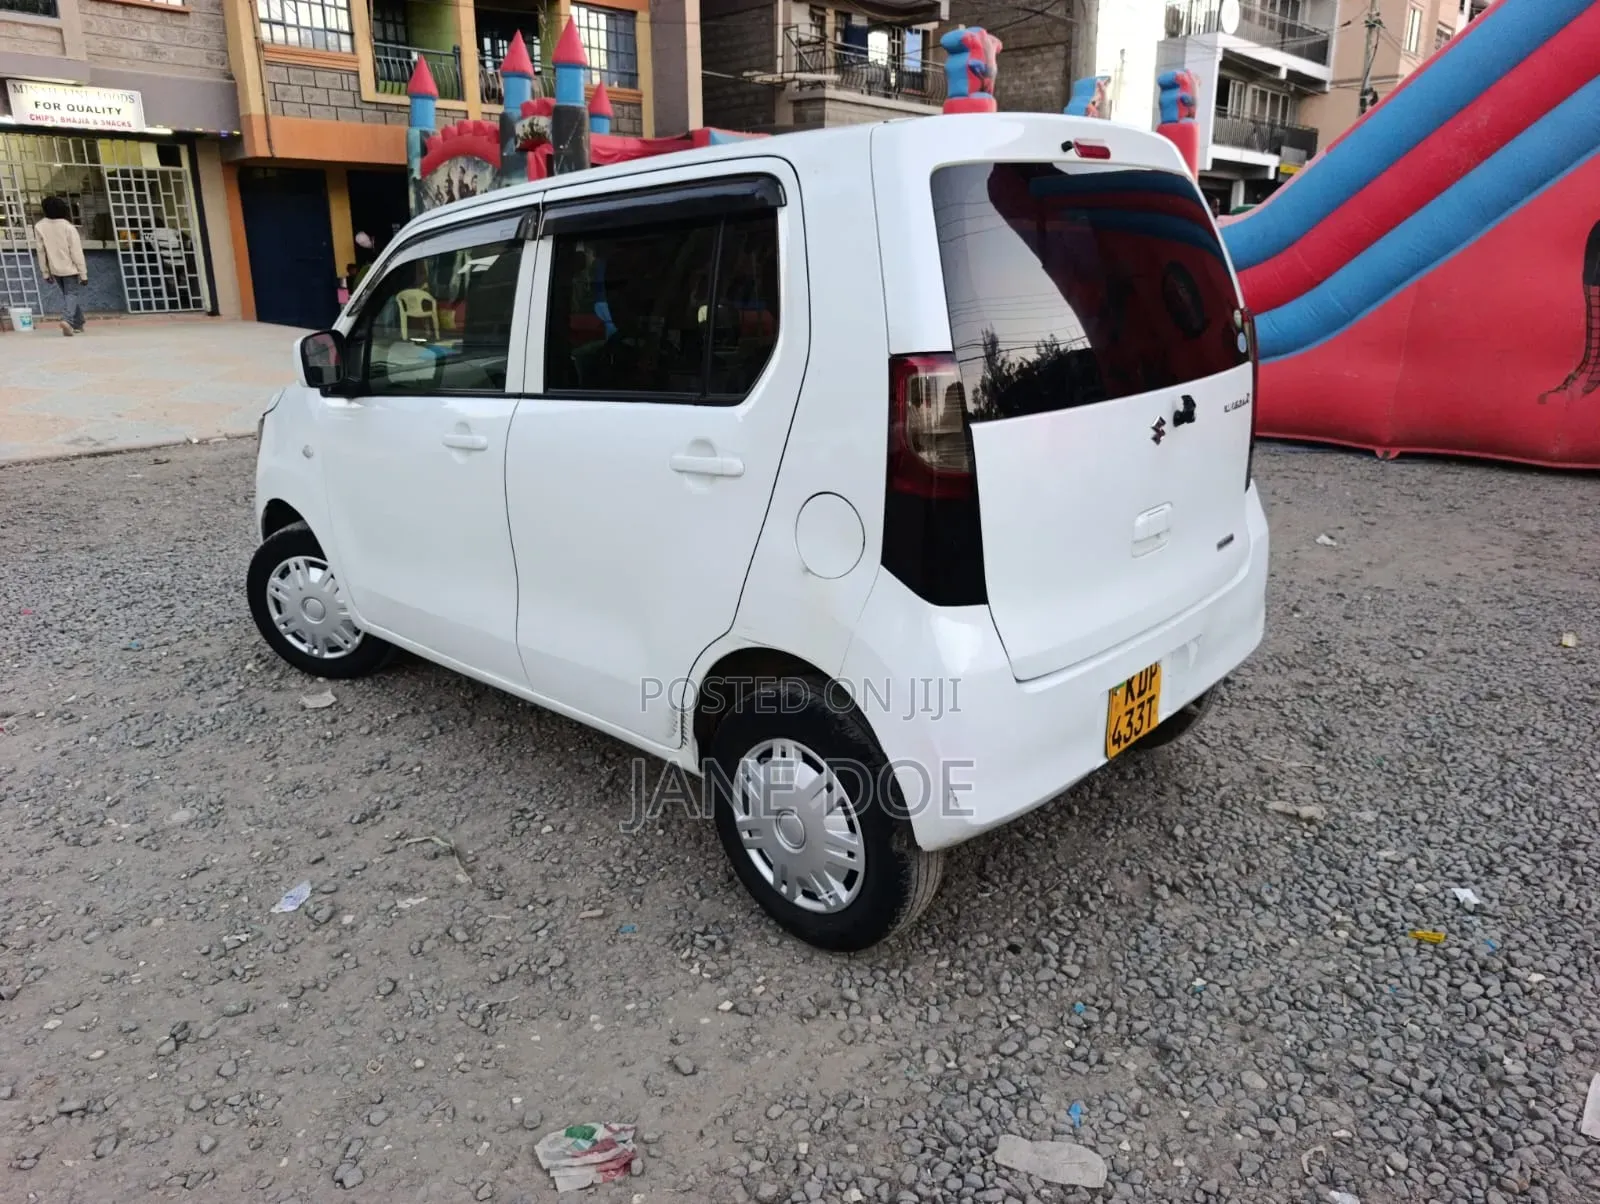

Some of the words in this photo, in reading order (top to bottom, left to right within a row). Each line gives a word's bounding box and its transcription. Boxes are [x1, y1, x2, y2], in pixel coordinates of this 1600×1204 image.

[34, 100, 61, 111] FOR
[66, 103, 122, 115] QUALITY
[100, 119, 132, 128] SNACKS
[1111, 694, 1156, 749] 433T
